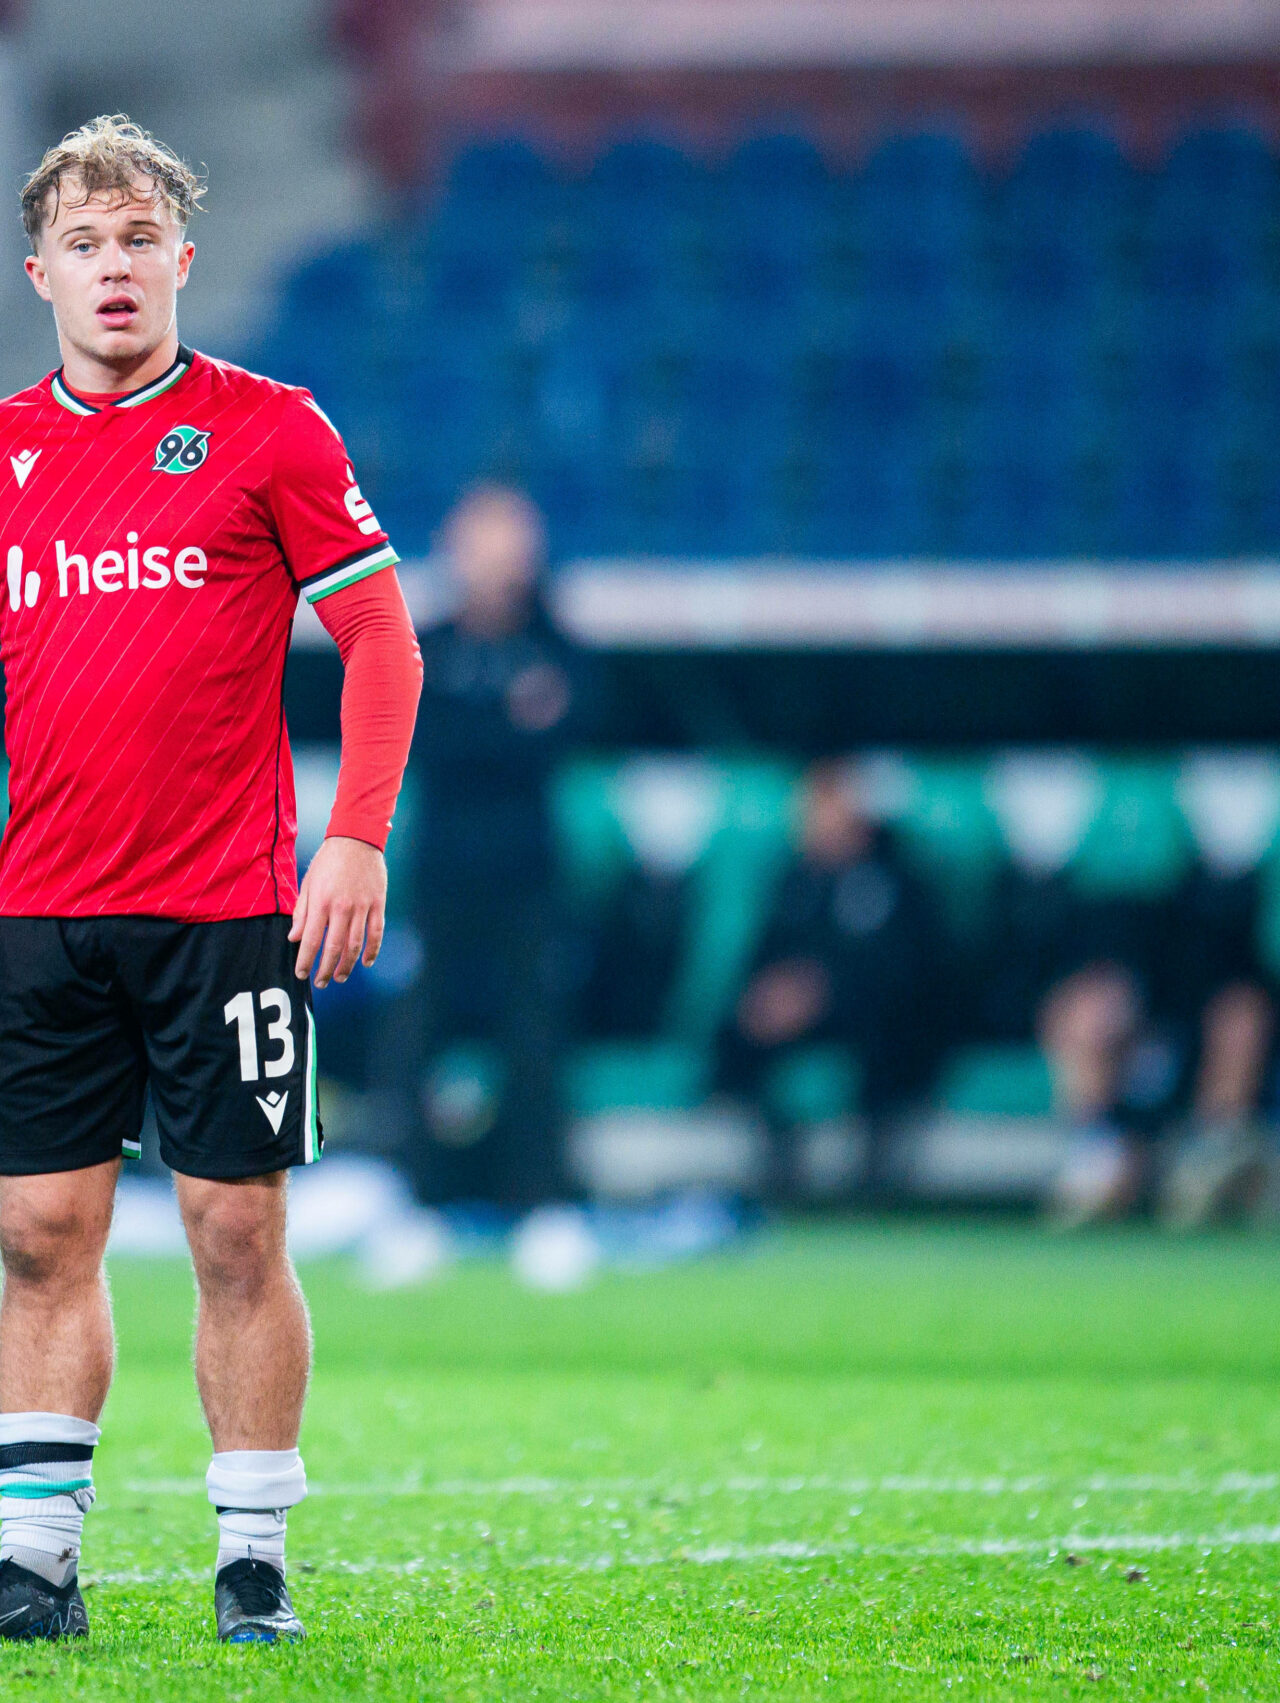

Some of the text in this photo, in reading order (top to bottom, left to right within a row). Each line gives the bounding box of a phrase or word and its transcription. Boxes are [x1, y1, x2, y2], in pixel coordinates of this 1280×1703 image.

[153, 430, 209, 469] 96
[55, 531, 208, 597] heise
[223, 987, 295, 1082] 13
